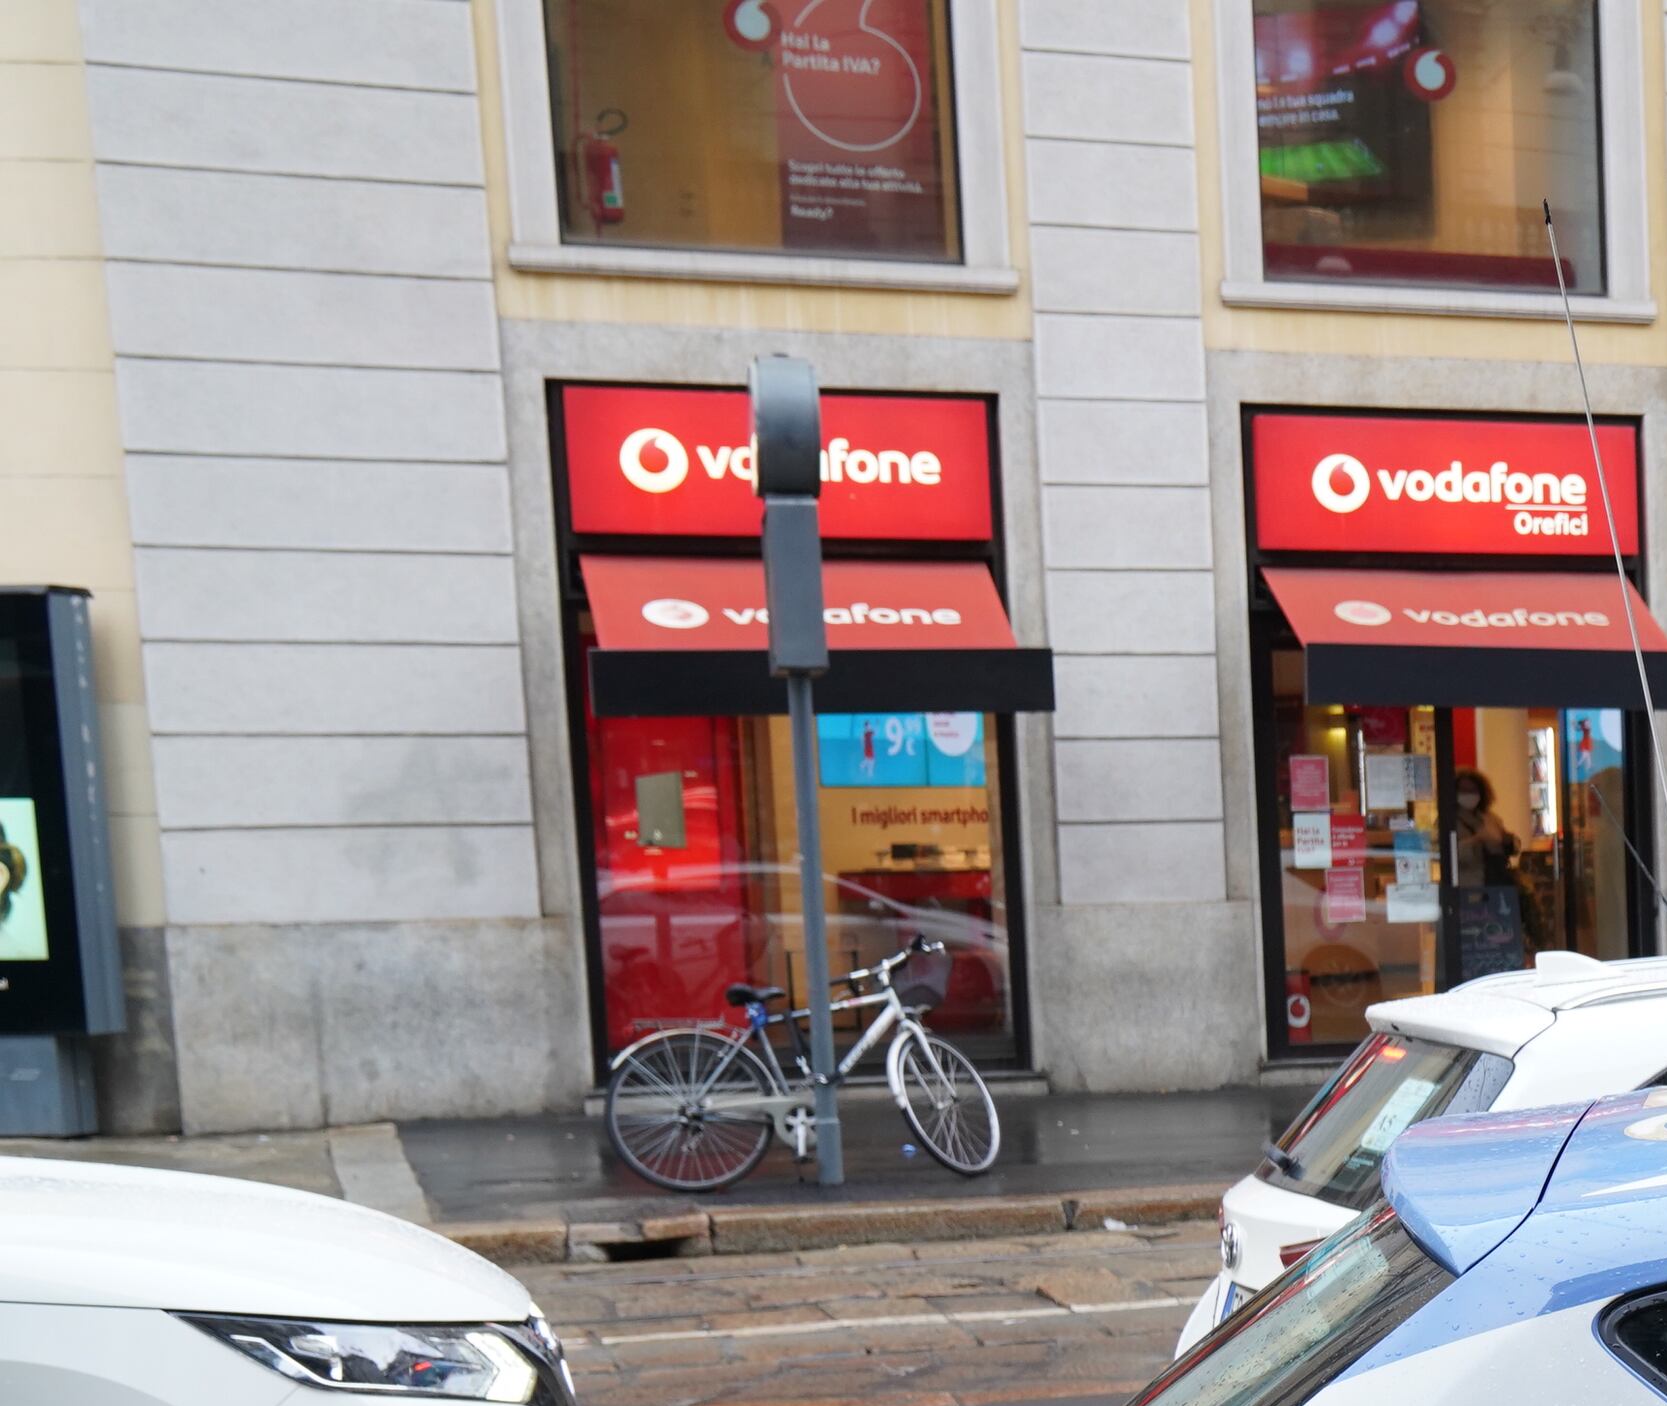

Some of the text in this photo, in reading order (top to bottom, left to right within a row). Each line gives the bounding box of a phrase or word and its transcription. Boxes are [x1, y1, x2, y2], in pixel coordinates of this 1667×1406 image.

[782, 51, 880, 75] Partita IVA?
[696, 438, 942, 485] vofone
[1377, 460, 1588, 505] vodafone
[1513, 511, 1589, 536] Orefici
[721, 601, 962, 625] voafone
[1402, 607, 1610, 628] vodafone
[860, 807, 918, 829] migliori
